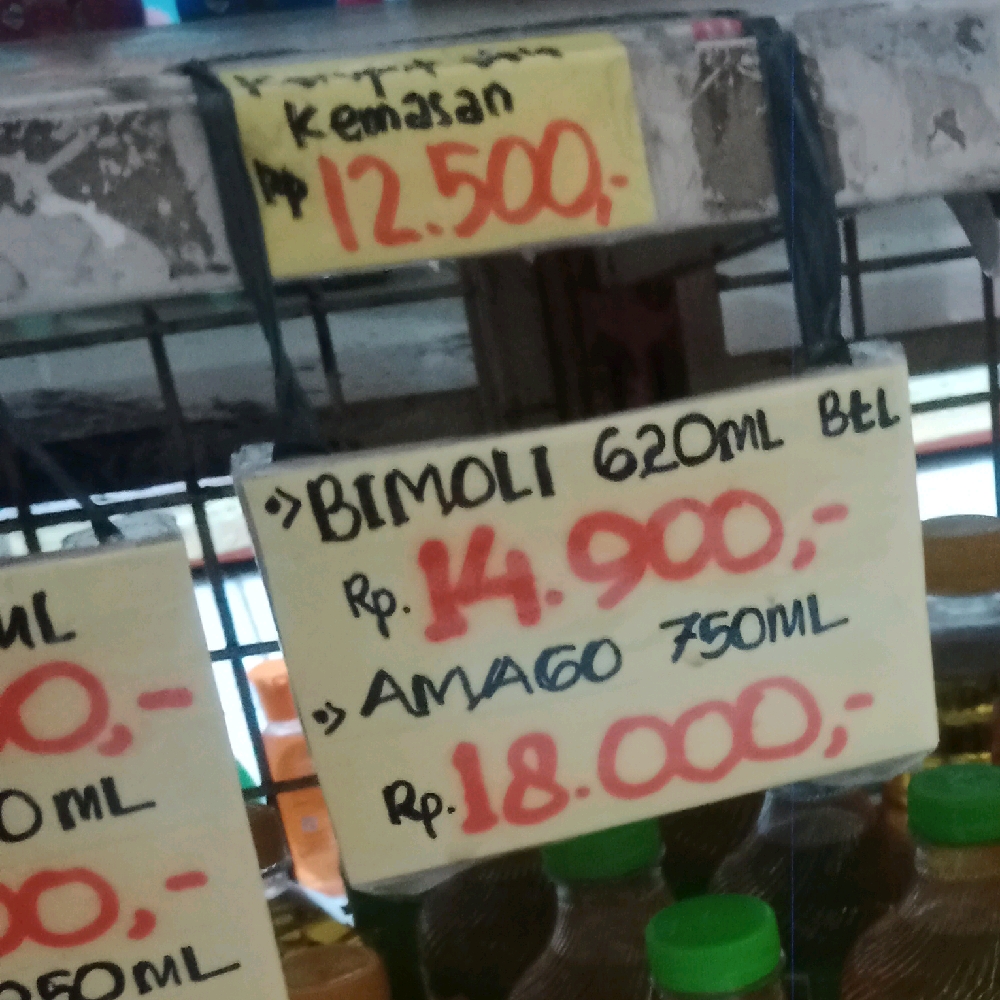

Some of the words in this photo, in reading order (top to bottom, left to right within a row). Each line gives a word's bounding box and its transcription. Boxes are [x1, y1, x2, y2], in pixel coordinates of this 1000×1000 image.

[307, 445, 556, 543] BIMOLI
[343, 572, 411, 638] Rp.
[417, 489, 849, 643] 14.900,-
[360, 637, 622, 718] AMAGO
[383, 779, 456, 838] Rp.
[451, 676, 873, 835] 18.000,-
